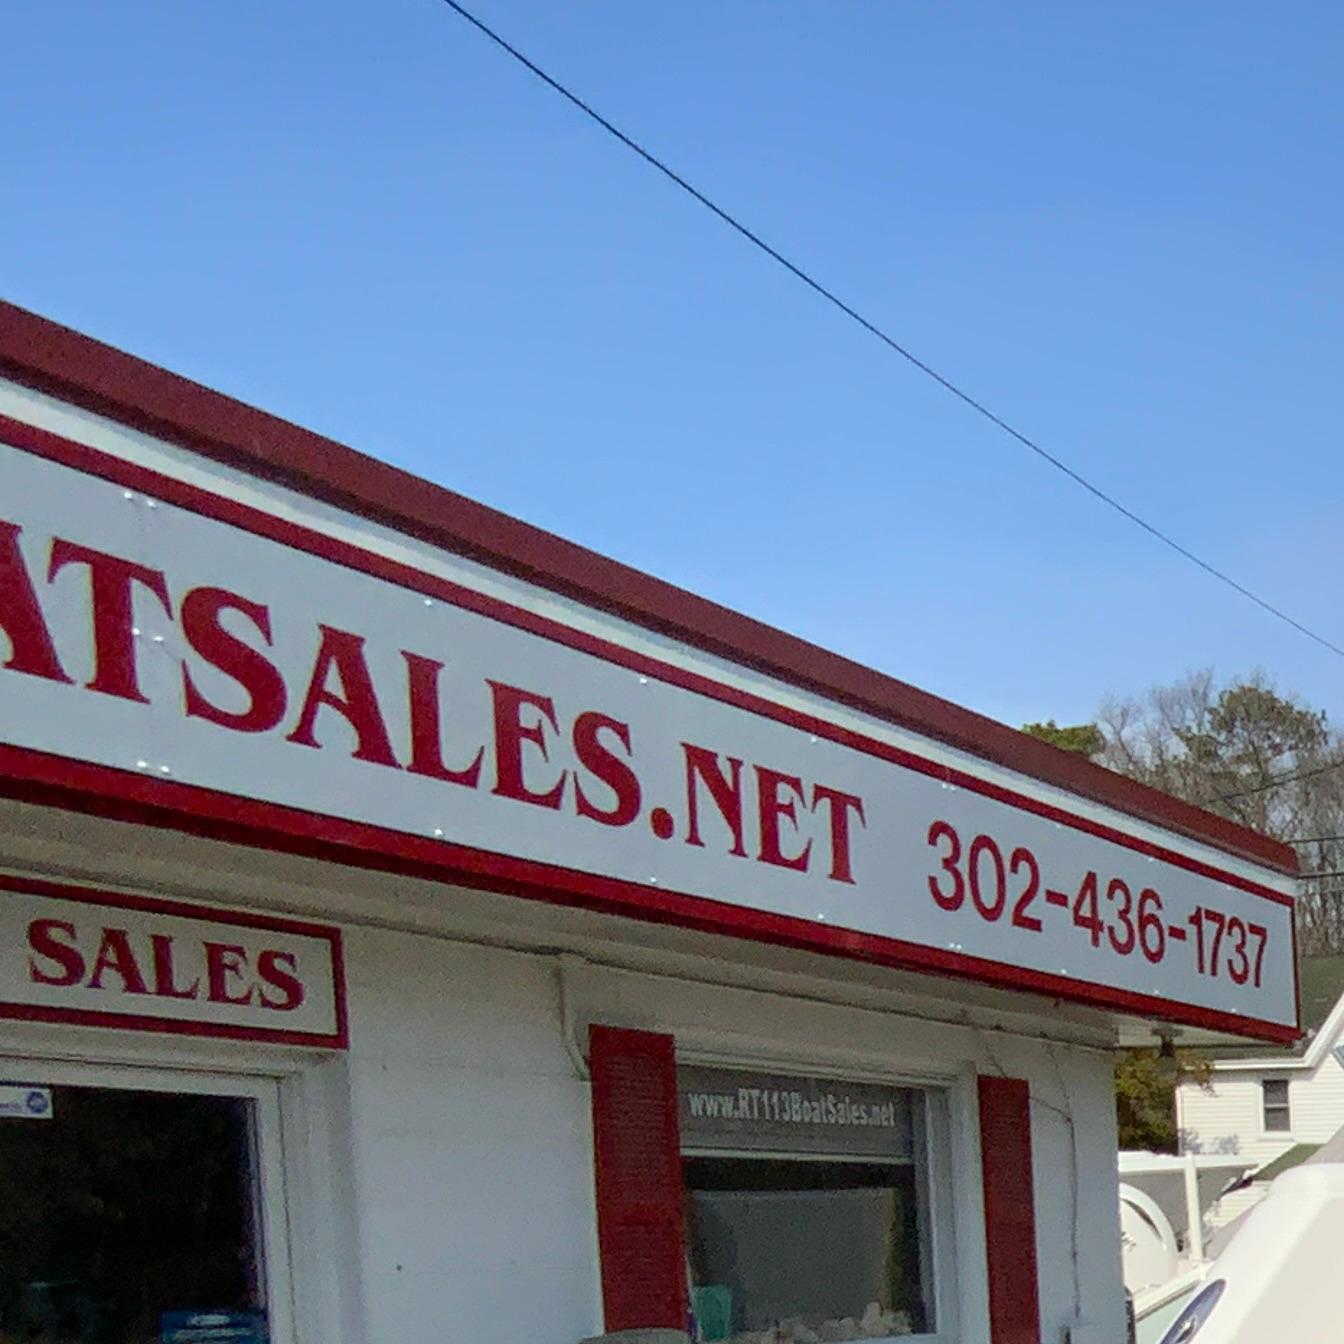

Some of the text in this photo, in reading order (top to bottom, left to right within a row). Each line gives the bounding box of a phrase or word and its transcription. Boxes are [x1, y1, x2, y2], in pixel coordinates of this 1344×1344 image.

[927, 819, 1268, 988] 302-436-1737
[26, 918, 306, 1012] SALES
[688, 1088, 896, 1127] www.RT113BoatSales.net
